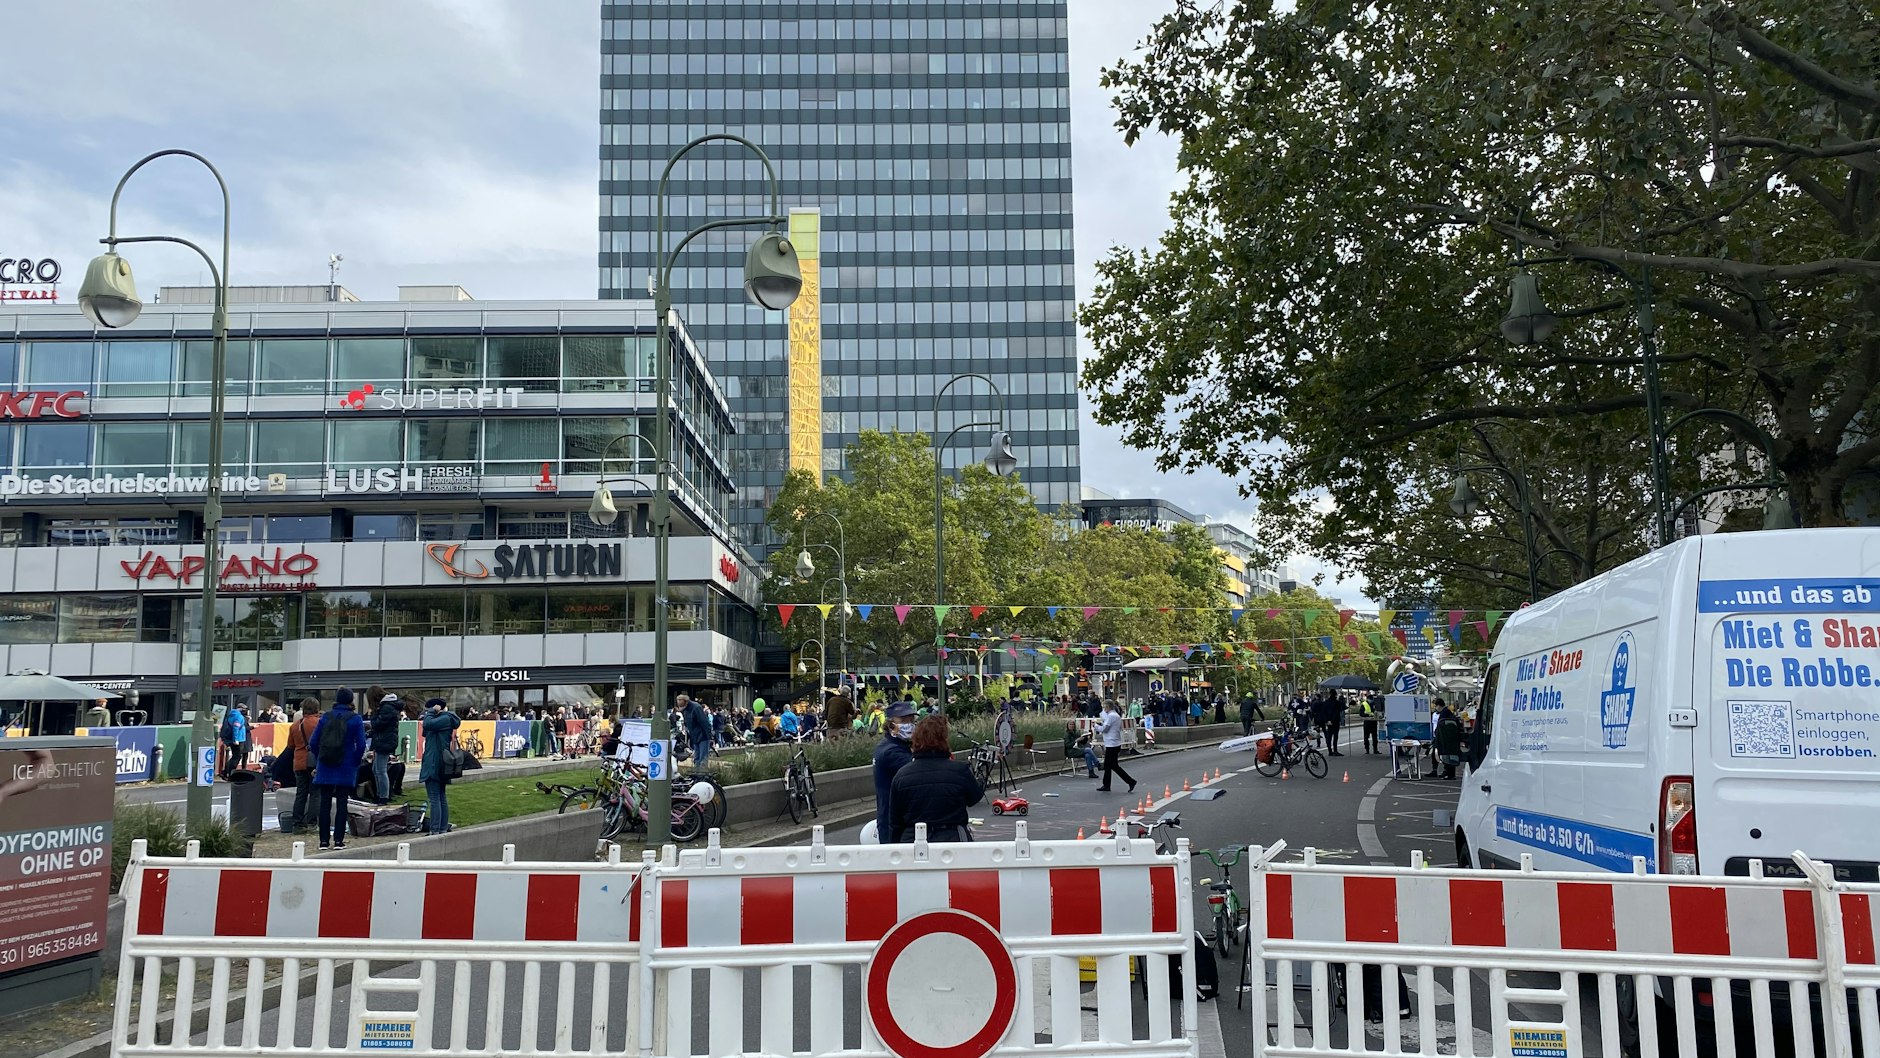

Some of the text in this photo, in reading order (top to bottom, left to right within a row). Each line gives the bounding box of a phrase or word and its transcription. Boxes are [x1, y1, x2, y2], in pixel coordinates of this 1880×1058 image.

[0, 391, 84, 418] KFC
[380, 387, 524, 410] SUPERFIT
[327, 467, 423, 492] LUSH
[429, 467, 472, 477] FRESH
[1, 472, 261, 494] Die Stachelschwine
[429, 484, 472, 492] COSMETICS
[120, 547, 318, 585] VAPANO
[494, 543, 622, 578] SATURN
[260, 583, 287, 591] PIZZA
[296, 582, 317, 591] BAR
[1714, 585, 1872, 605] ...und das ab
[1722, 620, 1785, 649] Miet
[1793, 618, 1813, 648] &
[1517, 649, 1583, 682] Miet & Share
[1725, 657, 1880, 687] Die Robbe.
[484, 670, 531, 682] FOSSIL
[1513, 685, 1564, 712] Die Robbe.
[1604, 692, 1631, 726] SHARE
[1795, 709, 1880, 723] Smartphone
[1797, 726, 1870, 741] einloggen,
[1799, 745, 1877, 758] losrobben.
[13, 764, 34, 780] ICE
[116, 756, 146, 773] RLIN
[1518, 818, 1534, 839] das
[1535, 823, 1547, 843] ab
[1575, 830, 1594, 856] €/h
[20, 847, 104, 875] OHNE OP
[1767, 865, 1850, 877] MAR
[365, 1023, 411, 1032] NIEMEIER
[1513, 1032, 1563, 1042] NIEMEIER
[1514, 1049, 1565, 1057] 01805-308050
